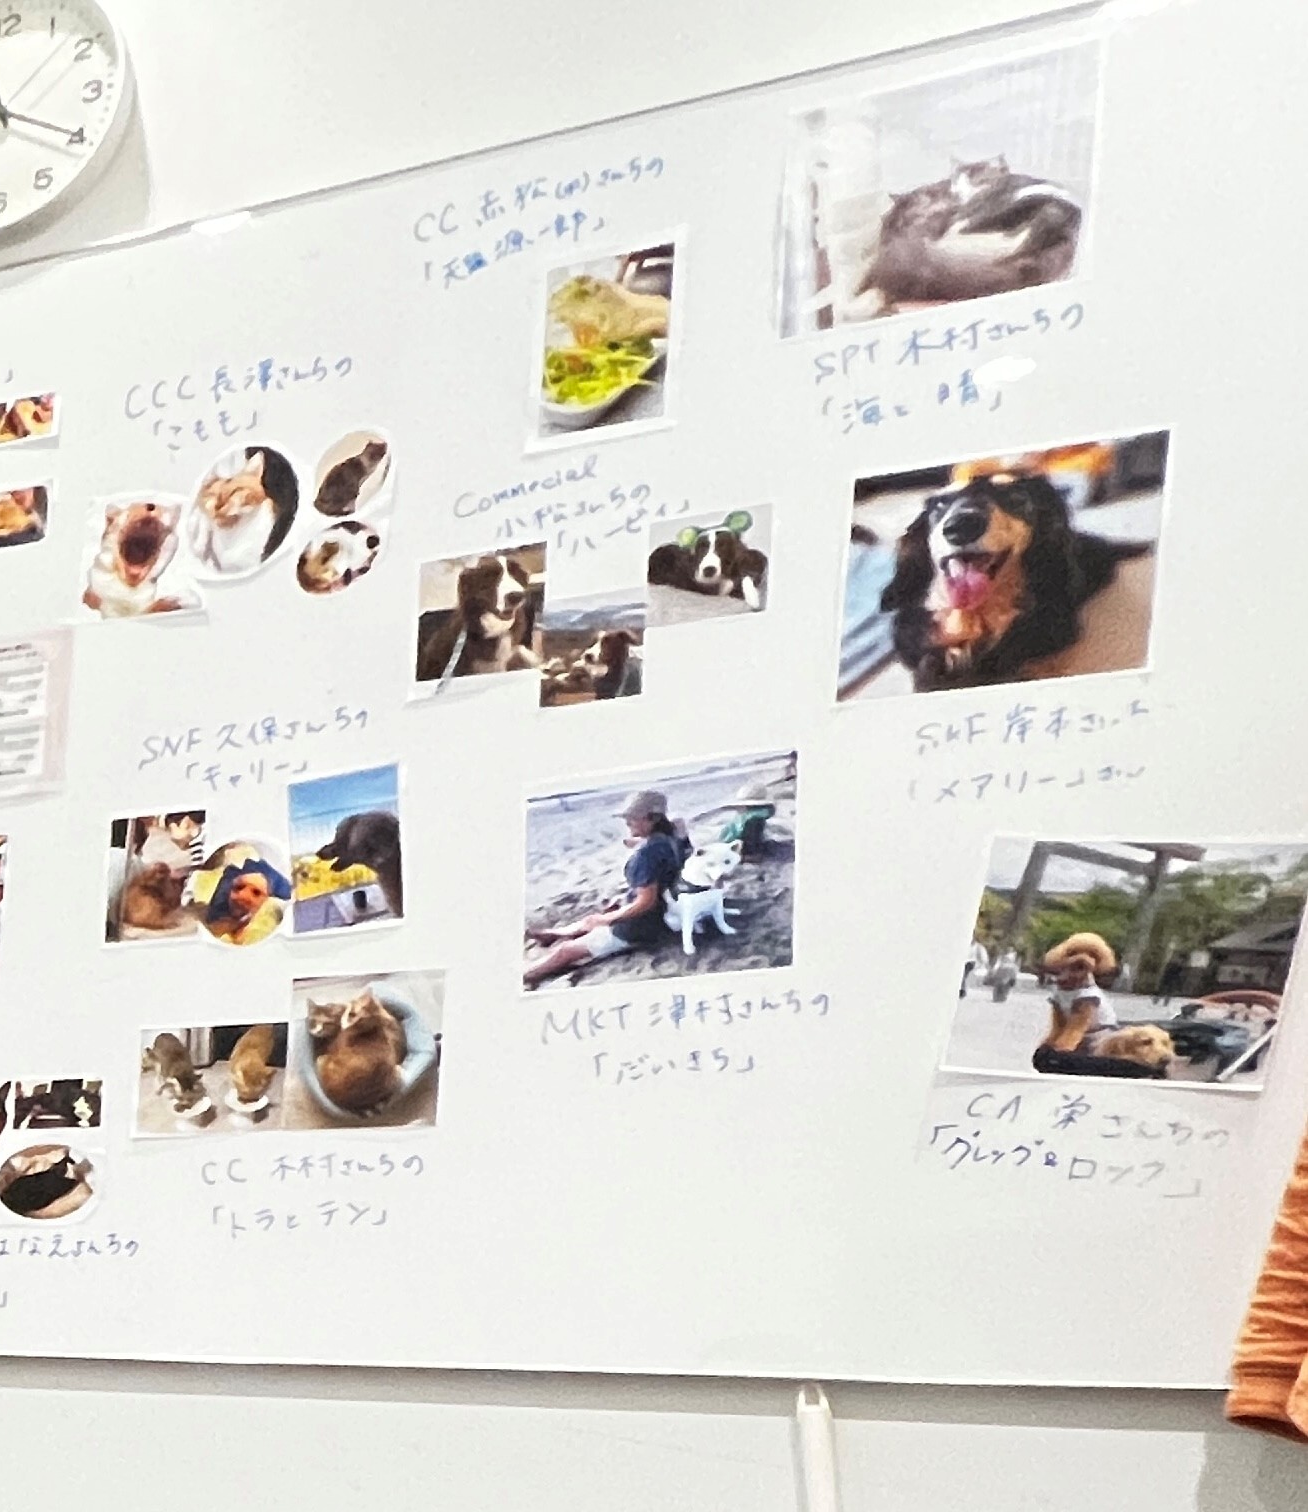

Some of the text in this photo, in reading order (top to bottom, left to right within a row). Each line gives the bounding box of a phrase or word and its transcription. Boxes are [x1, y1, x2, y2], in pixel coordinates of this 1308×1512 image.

[50, 16, 56, 38] 1
[74, 38, 94, 61] 2
[82, 79, 103, 103] 3
[814, 339, 881, 385] SPT
[124, 375, 196, 420] CCC
[138, 727, 203, 771] SNF
[541, 1001, 633, 1045] MKT
[966, 1093, 1022, 1123] CA
[200, 1158, 248, 1186] CC
